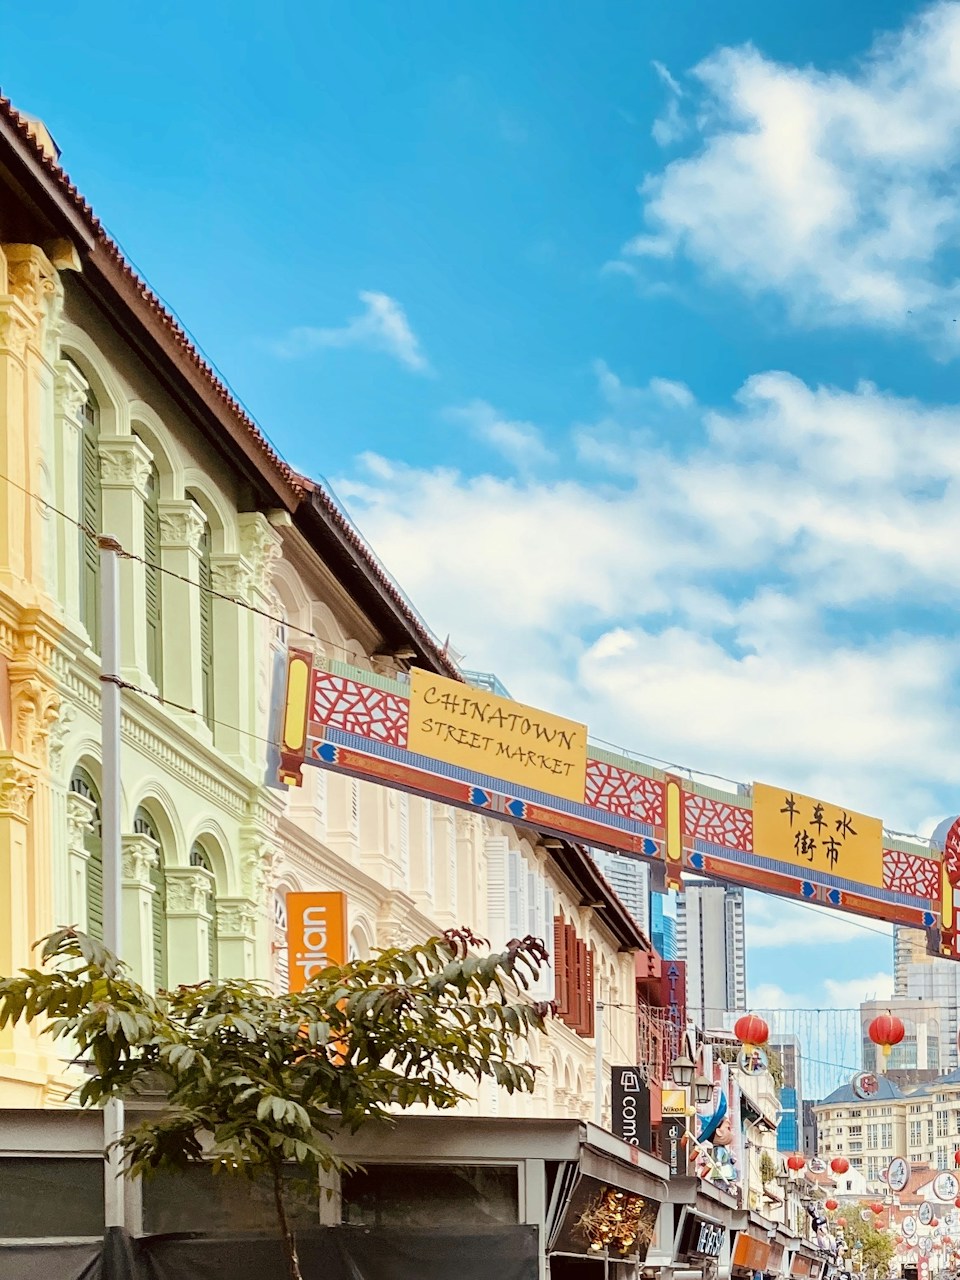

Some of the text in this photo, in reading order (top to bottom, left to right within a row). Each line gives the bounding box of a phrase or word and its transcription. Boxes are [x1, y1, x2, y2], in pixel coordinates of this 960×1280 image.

[423, 687, 577, 751] CHINATOWN
[421, 718, 576, 777] STREET MARKET
[779, 793, 858, 839] 牛车水
[793, 829, 843, 871] 街市
